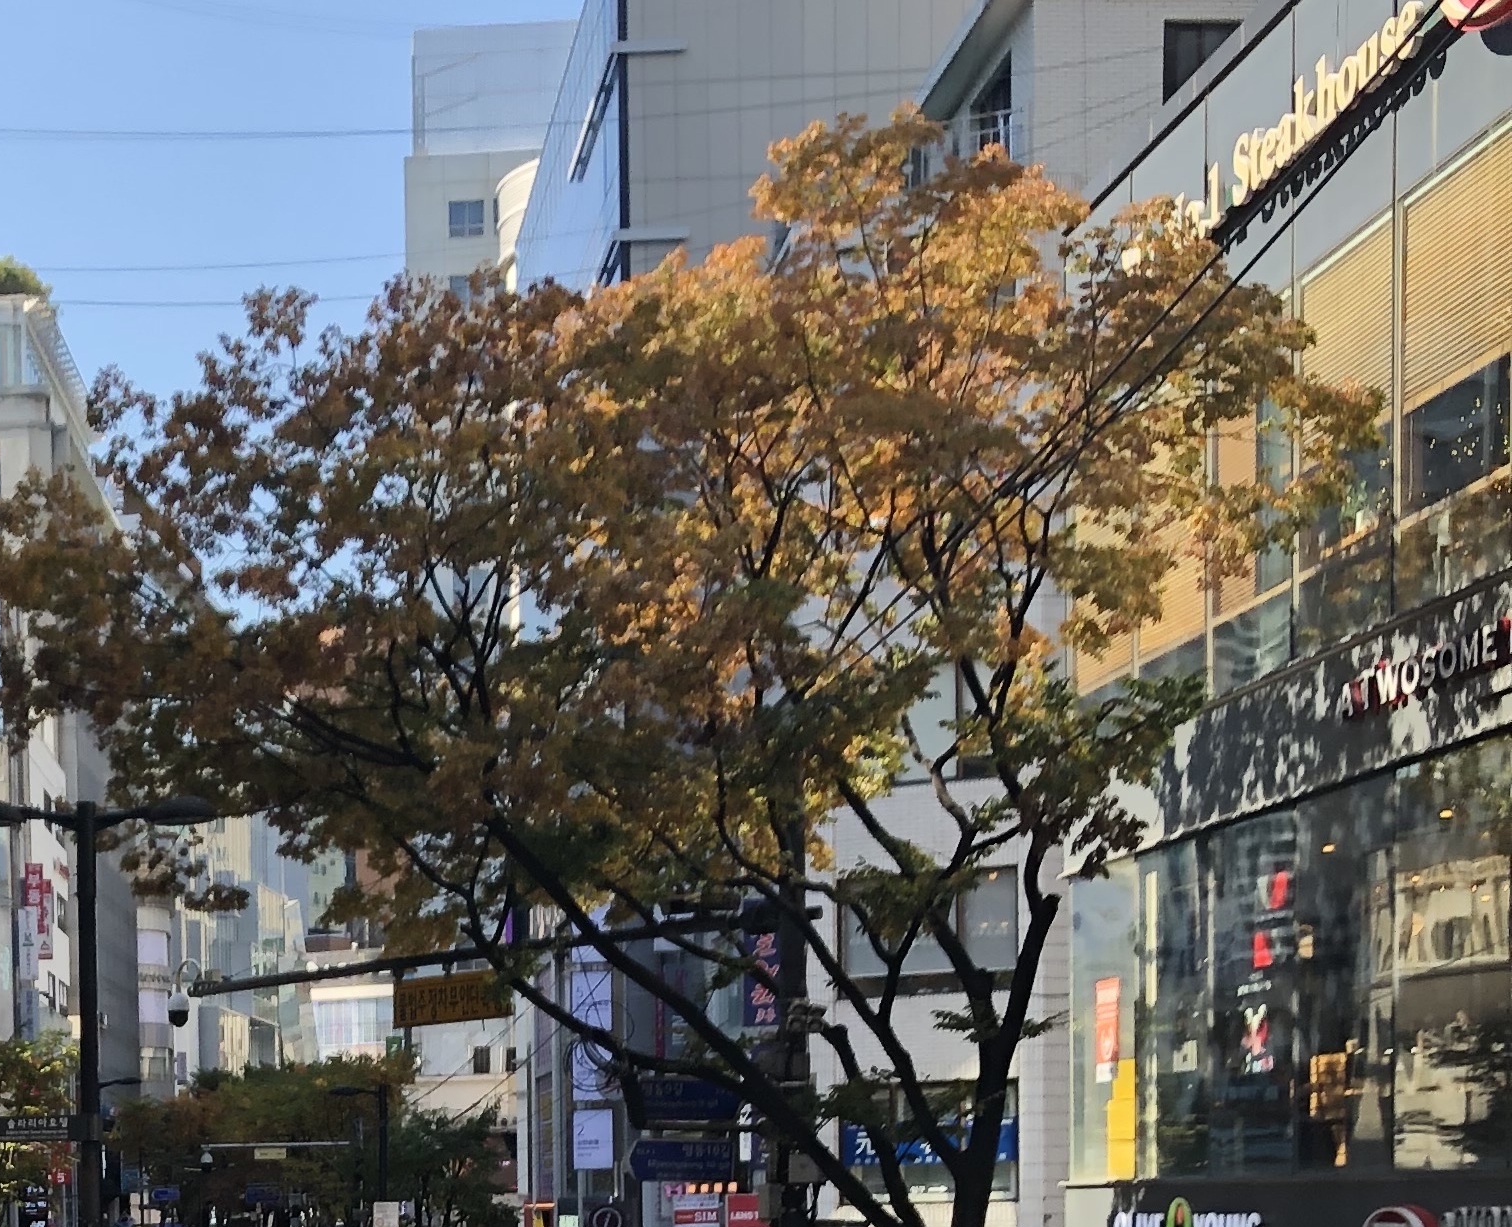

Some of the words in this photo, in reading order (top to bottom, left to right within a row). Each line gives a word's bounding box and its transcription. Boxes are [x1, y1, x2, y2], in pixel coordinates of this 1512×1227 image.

[1231, 0, 1426, 207] Steakhouse
[1358, 624, 1498, 711] TWOSOME
[694, 1210, 718, 1222] SIM
